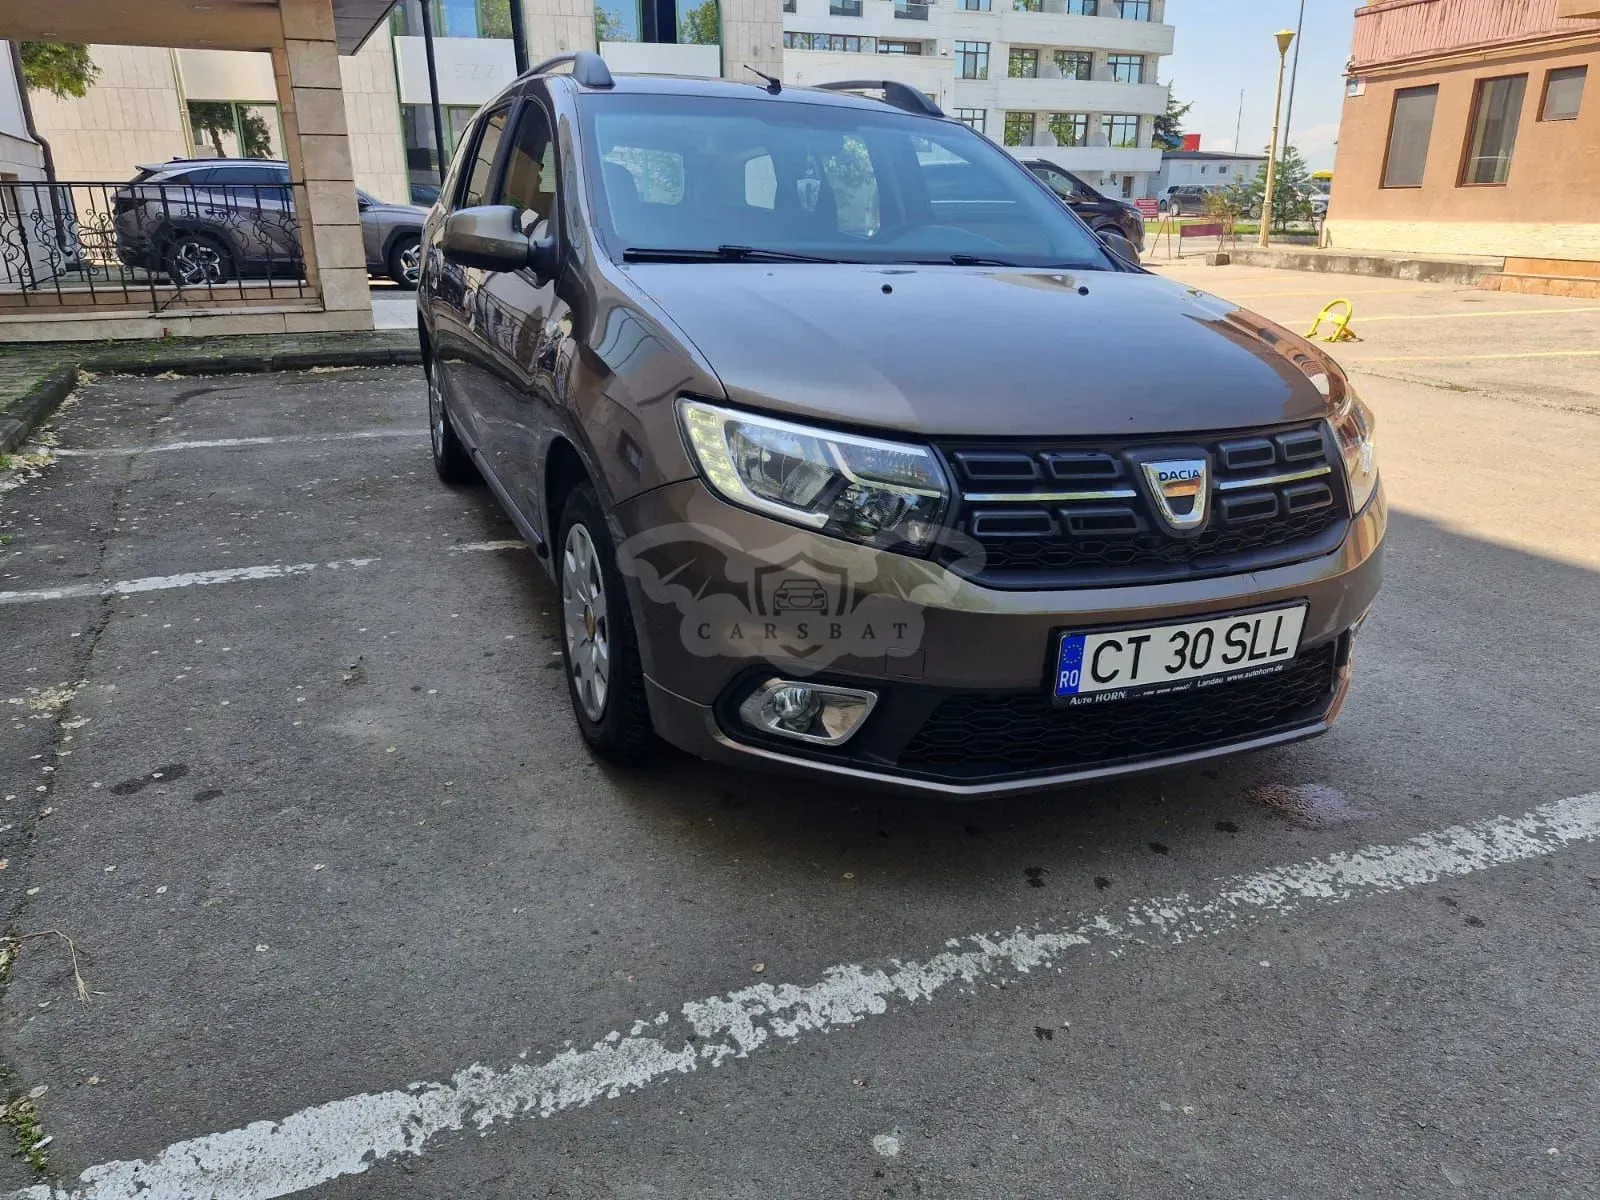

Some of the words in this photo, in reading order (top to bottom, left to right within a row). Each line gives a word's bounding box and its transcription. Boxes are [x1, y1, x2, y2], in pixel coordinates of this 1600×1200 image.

[1158, 470, 1201, 481] DACIA
[1091, 635, 1151, 683] CT
[1165, 627, 1214, 674] 30
[1222, 615, 1289, 665] SLL
[1060, 669, 1079, 689] RO
[1095, 691, 1126, 703] HORN
[1197, 677, 1224, 688] Landau
[1227, 664, 1283, 680] www.autohorn.de
